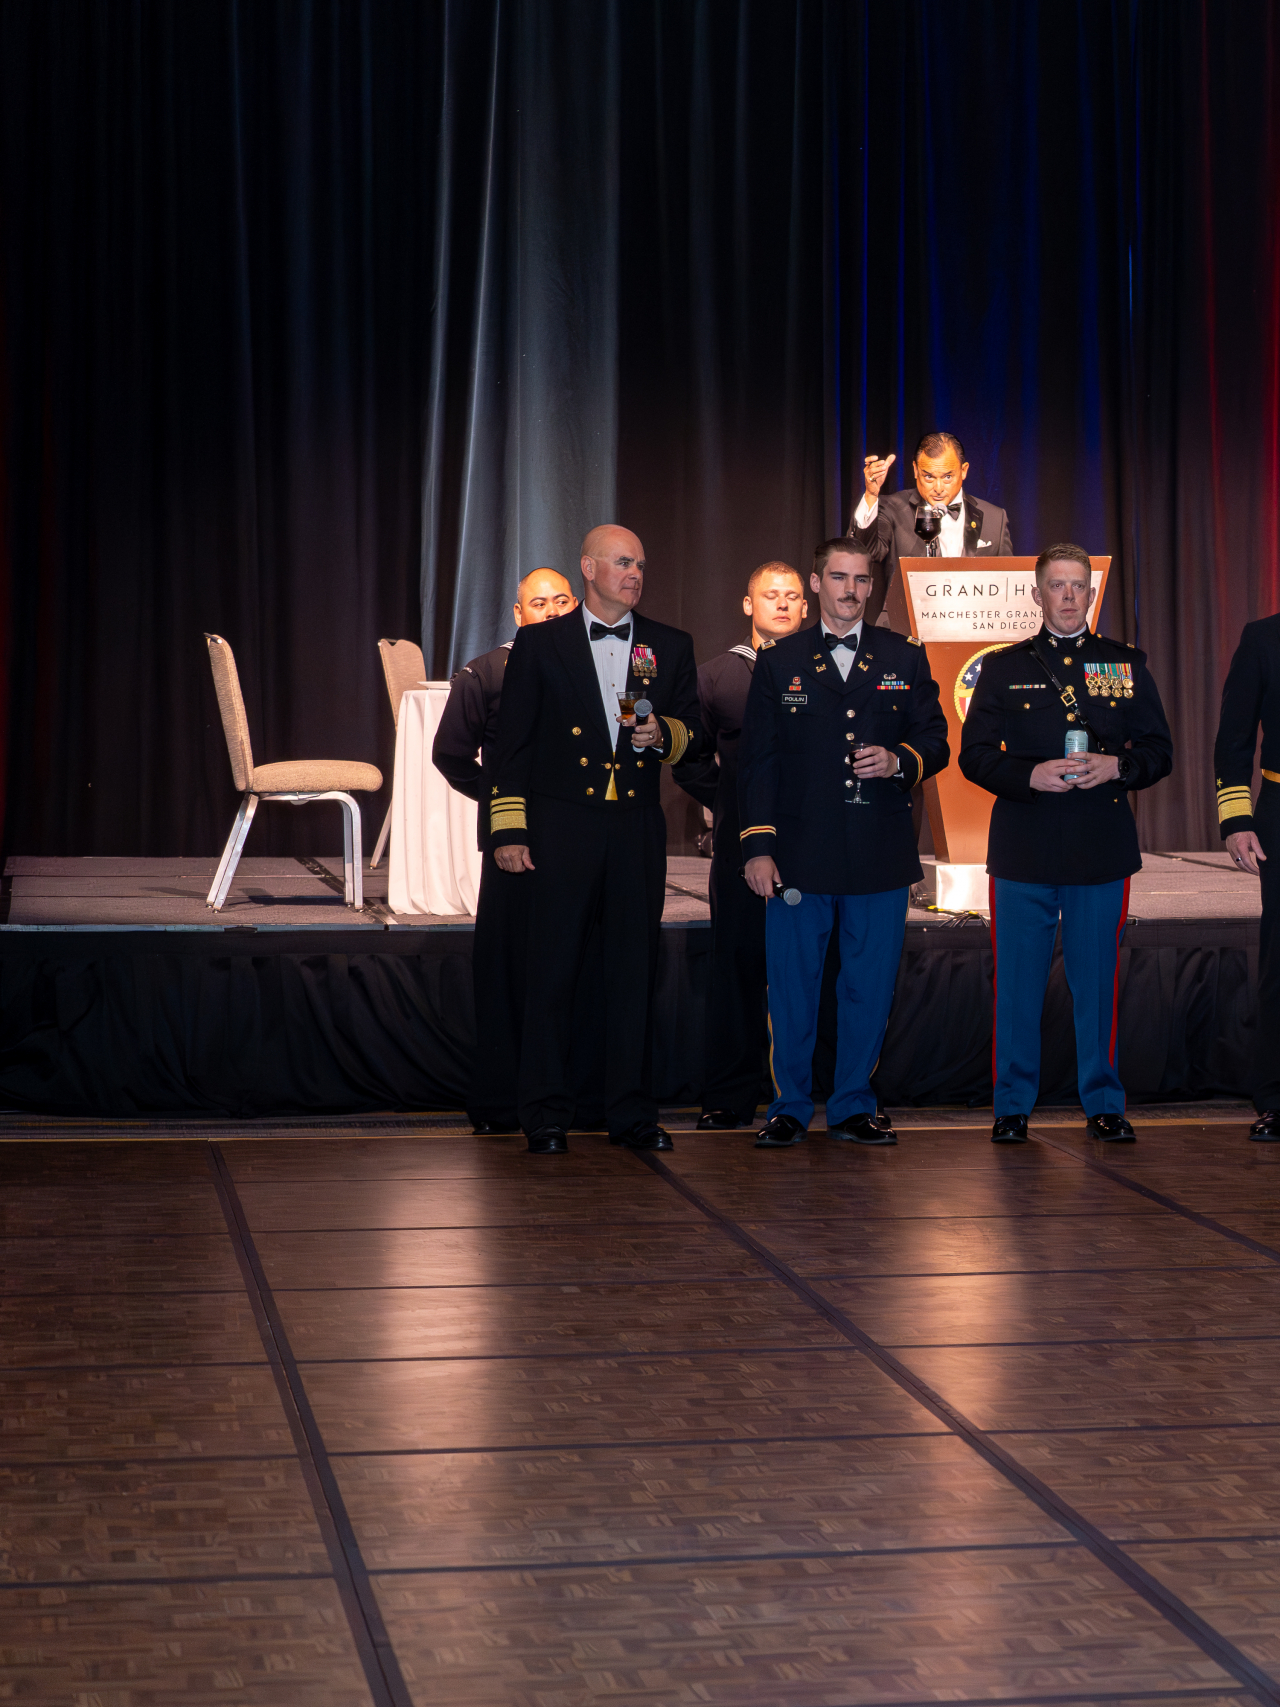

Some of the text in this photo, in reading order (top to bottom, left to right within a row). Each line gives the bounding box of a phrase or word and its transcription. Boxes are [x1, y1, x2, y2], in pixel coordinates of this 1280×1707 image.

[925, 584, 999, 597] GRAND
[921, 610, 1001, 619] MANCHESTER
[972, 621, 1036, 630] SAN DIEGO
